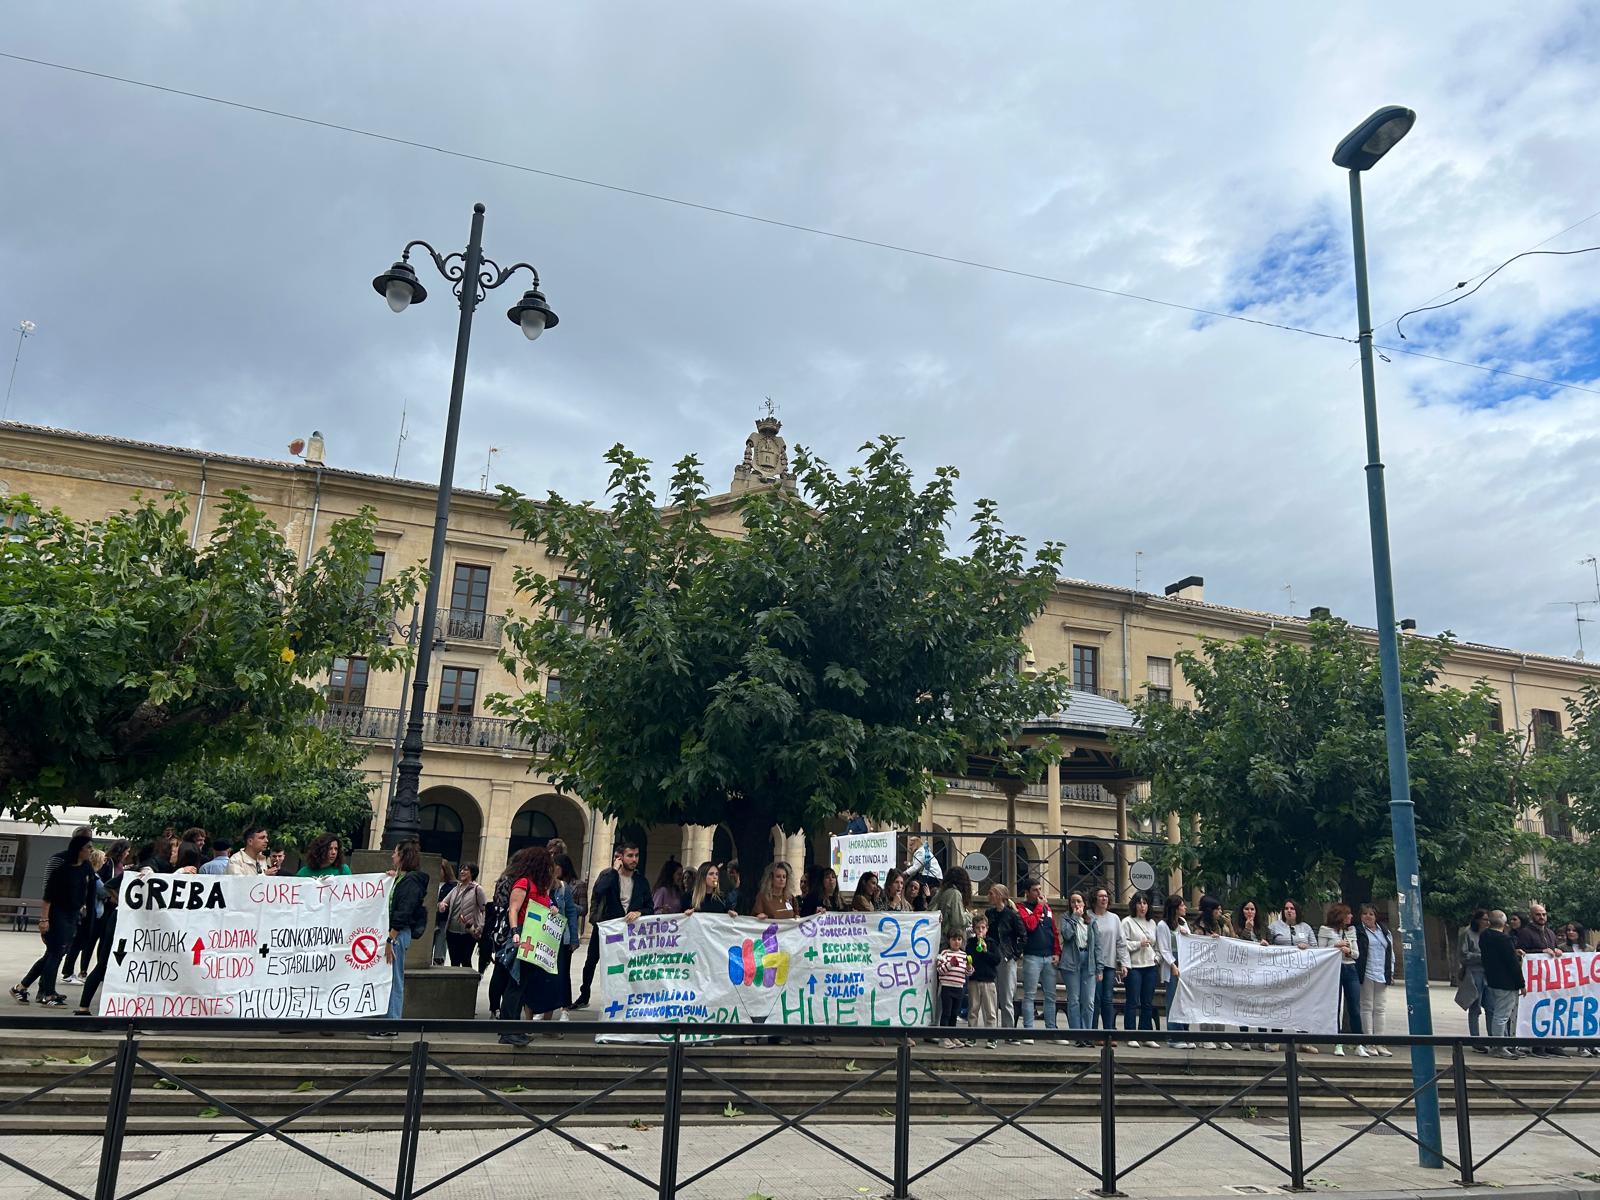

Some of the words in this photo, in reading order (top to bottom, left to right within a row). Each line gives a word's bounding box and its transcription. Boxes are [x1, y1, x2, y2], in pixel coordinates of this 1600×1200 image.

[1132, 872, 1154, 880] GORRITI
[124, 879, 227, 911] GREBA
[249, 882, 304, 905] GURE
[316, 880, 386, 903] TXANDA
[627, 917, 679, 937] RATIOS
[819, 927, 868, 938] SOBRECARGA
[878, 916, 931, 960] 26
[133, 928, 187, 954] RATIOAK
[206, 929, 257, 951] SOLDATAK
[628, 934, 681, 952] RATIOAK
[822, 942, 870, 954] RECURSOS
[267, 954, 337, 976] ESTABILIDAD
[1188, 941, 1219, 963] POR
[1227, 943, 1249, 966] UNA
[1257, 947, 1317, 970] ESCUELA
[125, 960, 180, 983] RATIOS
[201, 956, 255, 980] SUELDOS
[628, 967, 690, 982] RECORTES
[824, 972, 865, 984] SOLDATA
[239, 982, 378, 1019] HUELGA
[627, 988, 696, 1005] ESTABILIDAD
[824, 984, 865, 998] SALARIO
[105, 996, 154, 1017] AHORA
[162, 995, 235, 1017] DOCENTES
[780, 987, 934, 1026] HUELGA
